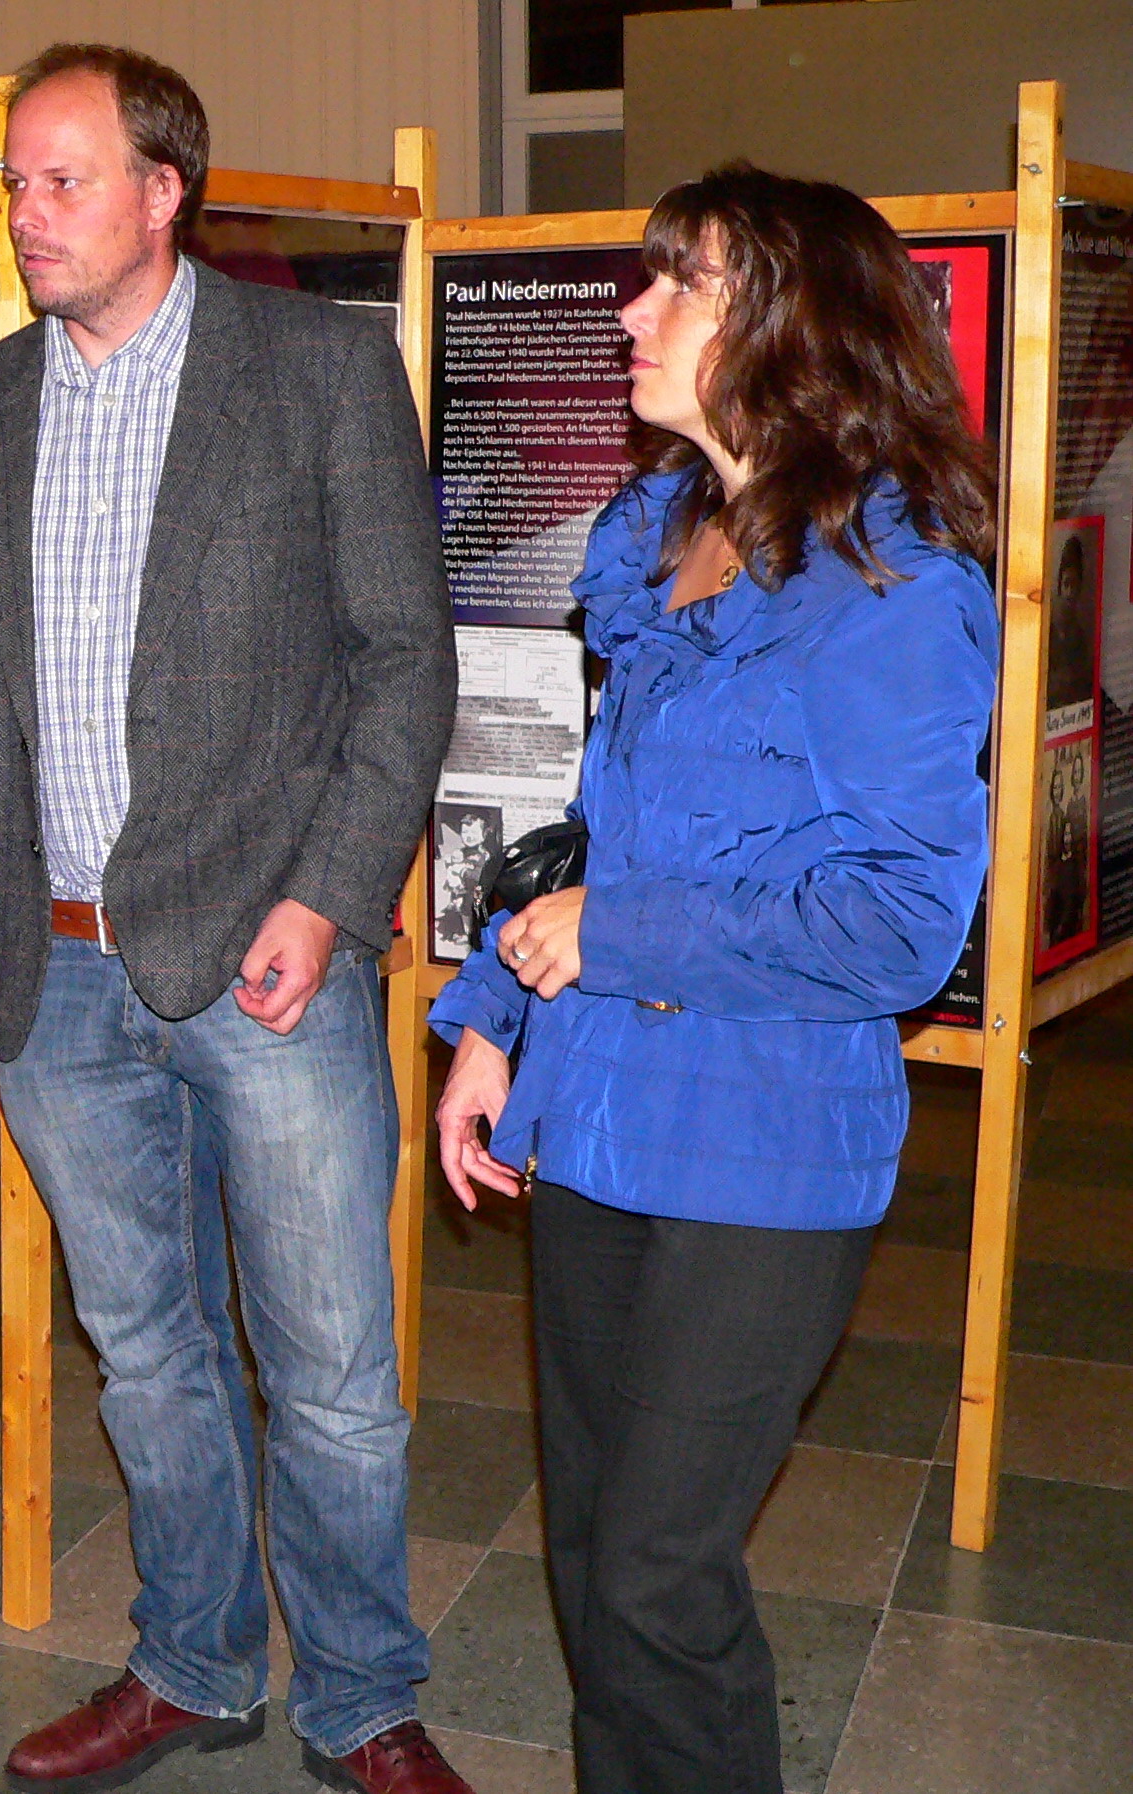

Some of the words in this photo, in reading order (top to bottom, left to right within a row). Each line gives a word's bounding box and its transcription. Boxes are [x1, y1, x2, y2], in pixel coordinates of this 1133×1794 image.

[445, 280, 486, 302] Paul
[492, 278, 617, 300] Niedermann
[446, 312, 463, 321] Paul
[465, 311, 513, 321] Niedermann
[515, 310, 540, 319] wurde
[574, 308, 612, 318] Karlsruhe
[446, 324, 497, 333] Herrenstraße
[532, 322, 554, 331] Vater
[555, 321, 581, 331] Albert
[527, 335, 566, 346] jüdischen
[568, 334, 611, 344] Gemeinde
[529, 348, 554, 357] wurde
[556, 347, 574, 356] Paul
[445, 361, 494, 371] Niedermann
[496, 361, 511, 370] und
[514, 361, 542, 370] seinem
[544, 360, 580, 372] jüngeren
[583, 360, 610, 369] Bruder
[445, 374, 487, 385] deportiert.
[488, 373, 505, 383] Paul
[507, 373, 556, 383] Niedermann
[558, 372, 591, 382] schreibt
[496, 398, 529, 408] Ankunft
[531, 399, 555, 408] waren
[572, 398, 597, 408] dieser
[444, 411, 472, 420] damals
[497, 411, 534, 420] Personen
[444, 424, 459, 432] den
[443, 436, 462, 445] auch
[476, 436, 513, 445] Schlamm
[568, 436, 598, 445] diesem
[599, 436, 626, 445] Winter
[443, 461, 481, 470] Nachdem
[496, 461, 525, 470] Familie
[471, 474, 498, 485] gelang
[500, 474, 516, 483] Paul
[518, 474, 569, 484] Niedermann
[571, 474, 587, 484] und
[589, 475, 619, 484] seinem
[457, 485, 496, 497] jüdischen
[484, 498, 501, 508] Paul
[503, 498, 552, 508] Niedermann
[527, 512, 549, 522] junge
[459, 523, 485, 532] Frauen
[487, 523, 519, 533] bestand
[488, 572, 519, 584] Morgen
[513, 598, 531, 608] dass
